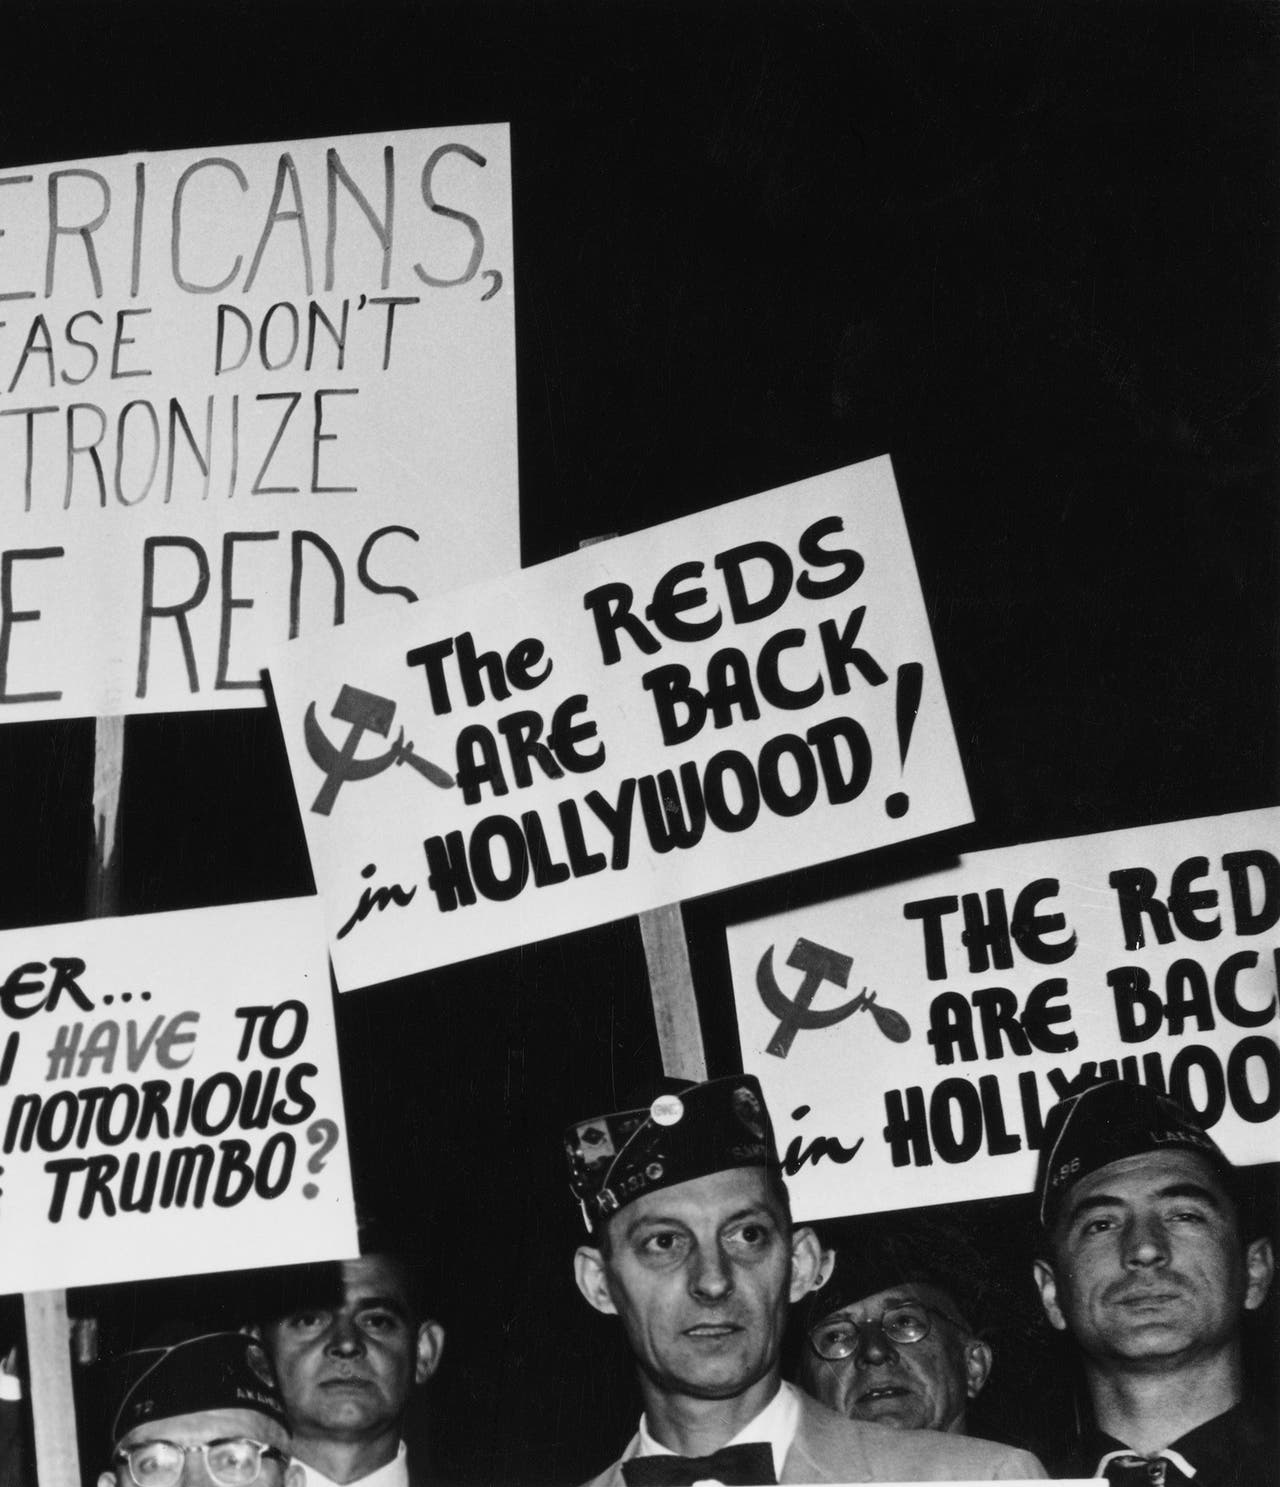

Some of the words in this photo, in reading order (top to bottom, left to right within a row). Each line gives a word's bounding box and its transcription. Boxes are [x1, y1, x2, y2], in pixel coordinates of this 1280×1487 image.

[214, 294, 420, 377] DON'T
[406, 631, 552, 716] The
[584, 515, 865, 665] REDS
[456, 694, 606, 805] ARE
[643, 606, 888, 747] BACK
[337, 864, 417, 939] in
[423, 662, 923, 913] HOLLYWOOD!
[903, 878, 1077, 980] THE
[1109, 849, 1280, 951] RED
[45, 1010, 200, 1081] HAVE
[235, 1000, 308, 1061] TO
[927, 978, 1079, 1065] ARE
[1107, 950, 1280, 1043] BAC
[3, 1063, 318, 1154] NOTORIOUS
[781, 1105, 863, 1176] in
[45, 1117, 338, 1222] TRUMBO?
